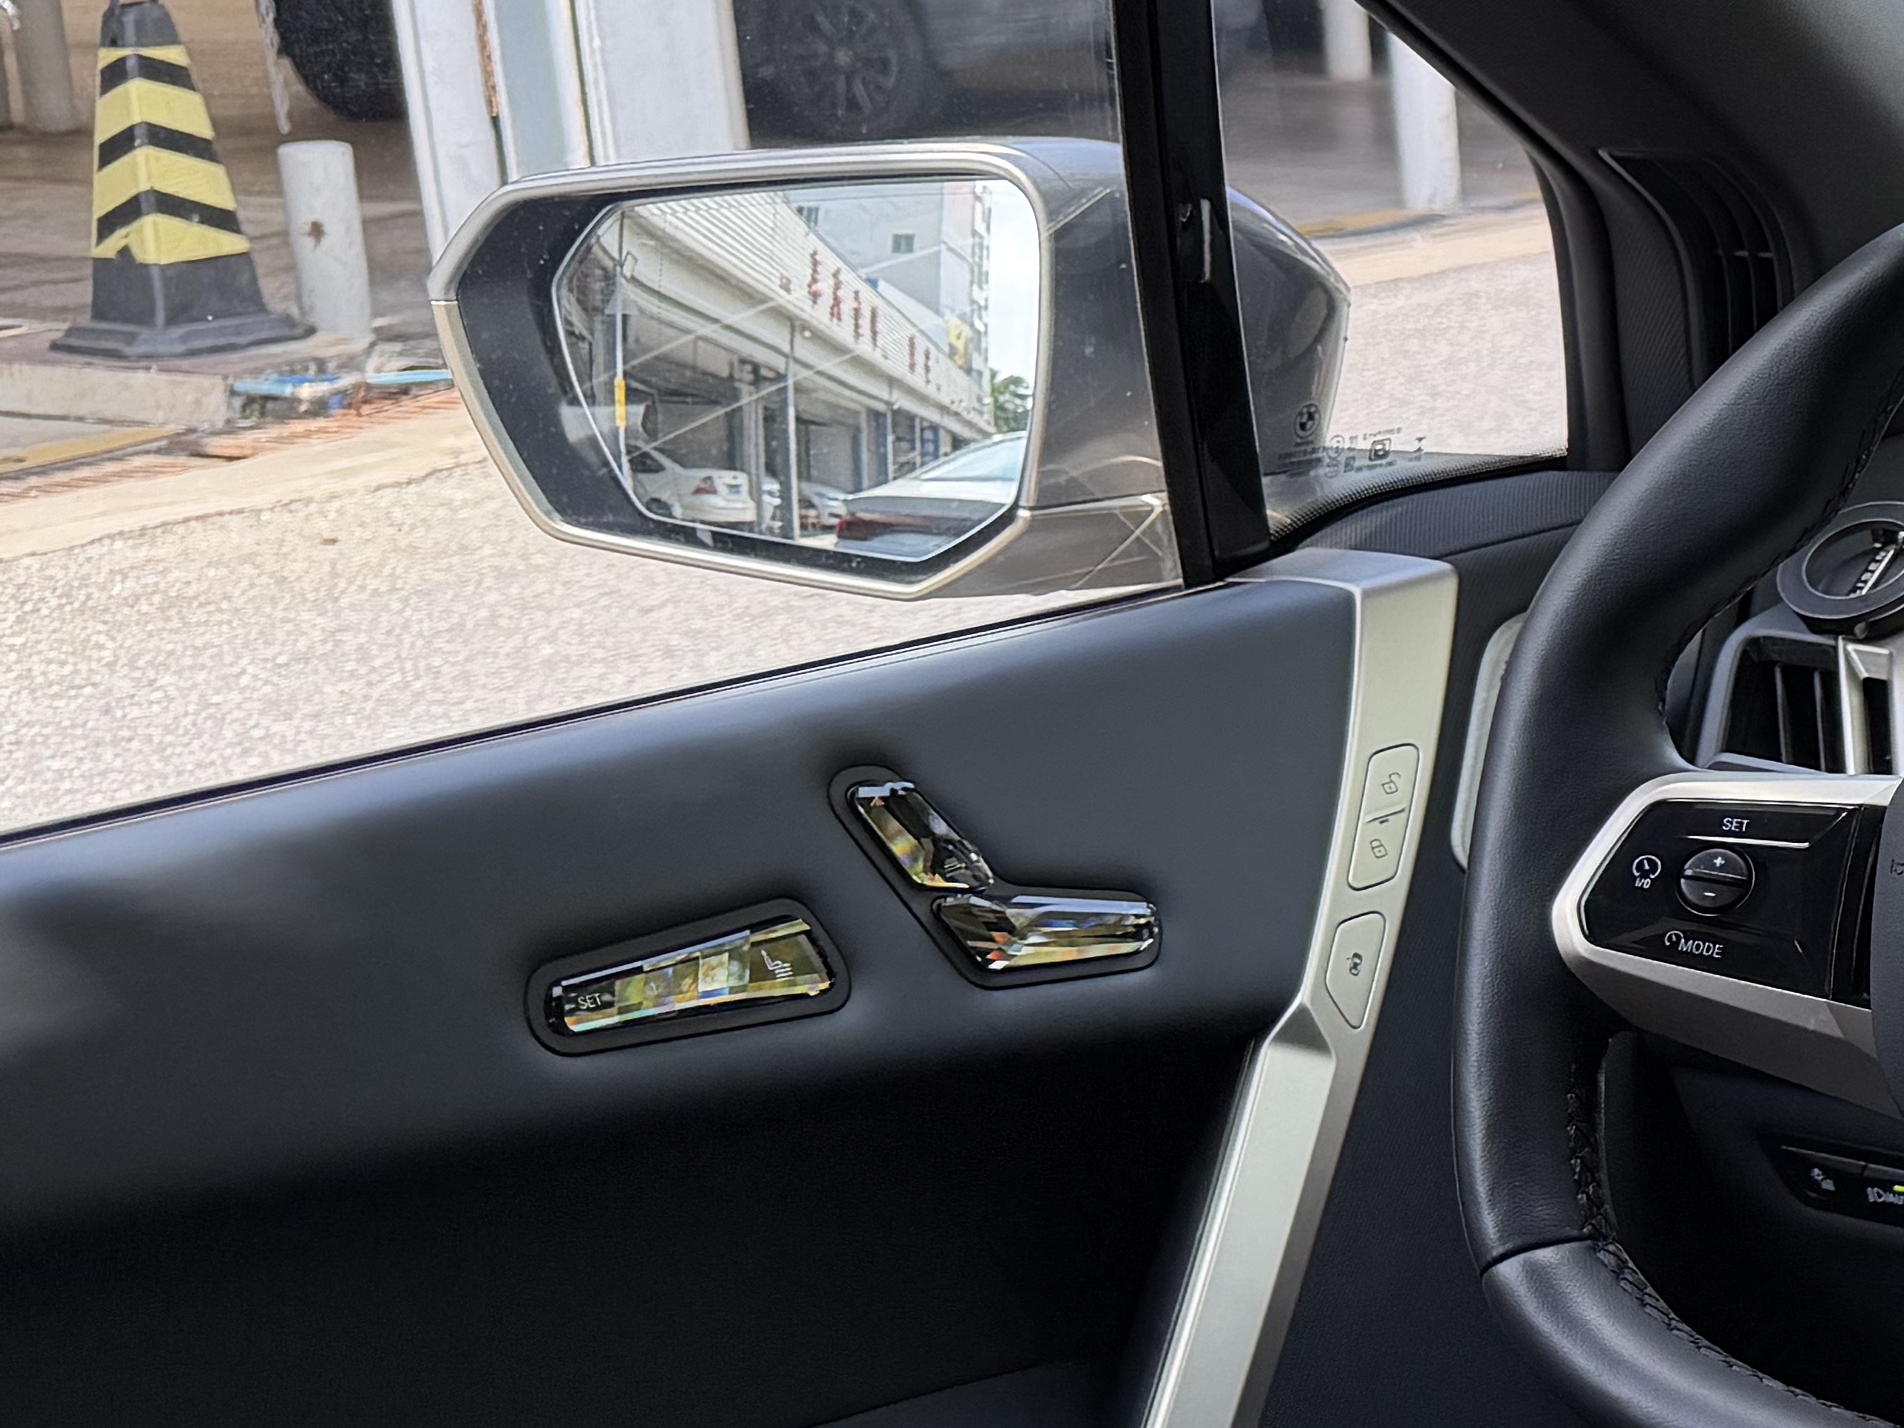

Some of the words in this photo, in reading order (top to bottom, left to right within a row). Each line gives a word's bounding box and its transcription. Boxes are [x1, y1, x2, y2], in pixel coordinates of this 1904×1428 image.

[1722, 818, 1750, 832] SET
[1678, 938, 1724, 958] MODE
[577, 993, 602, 1009] SET
